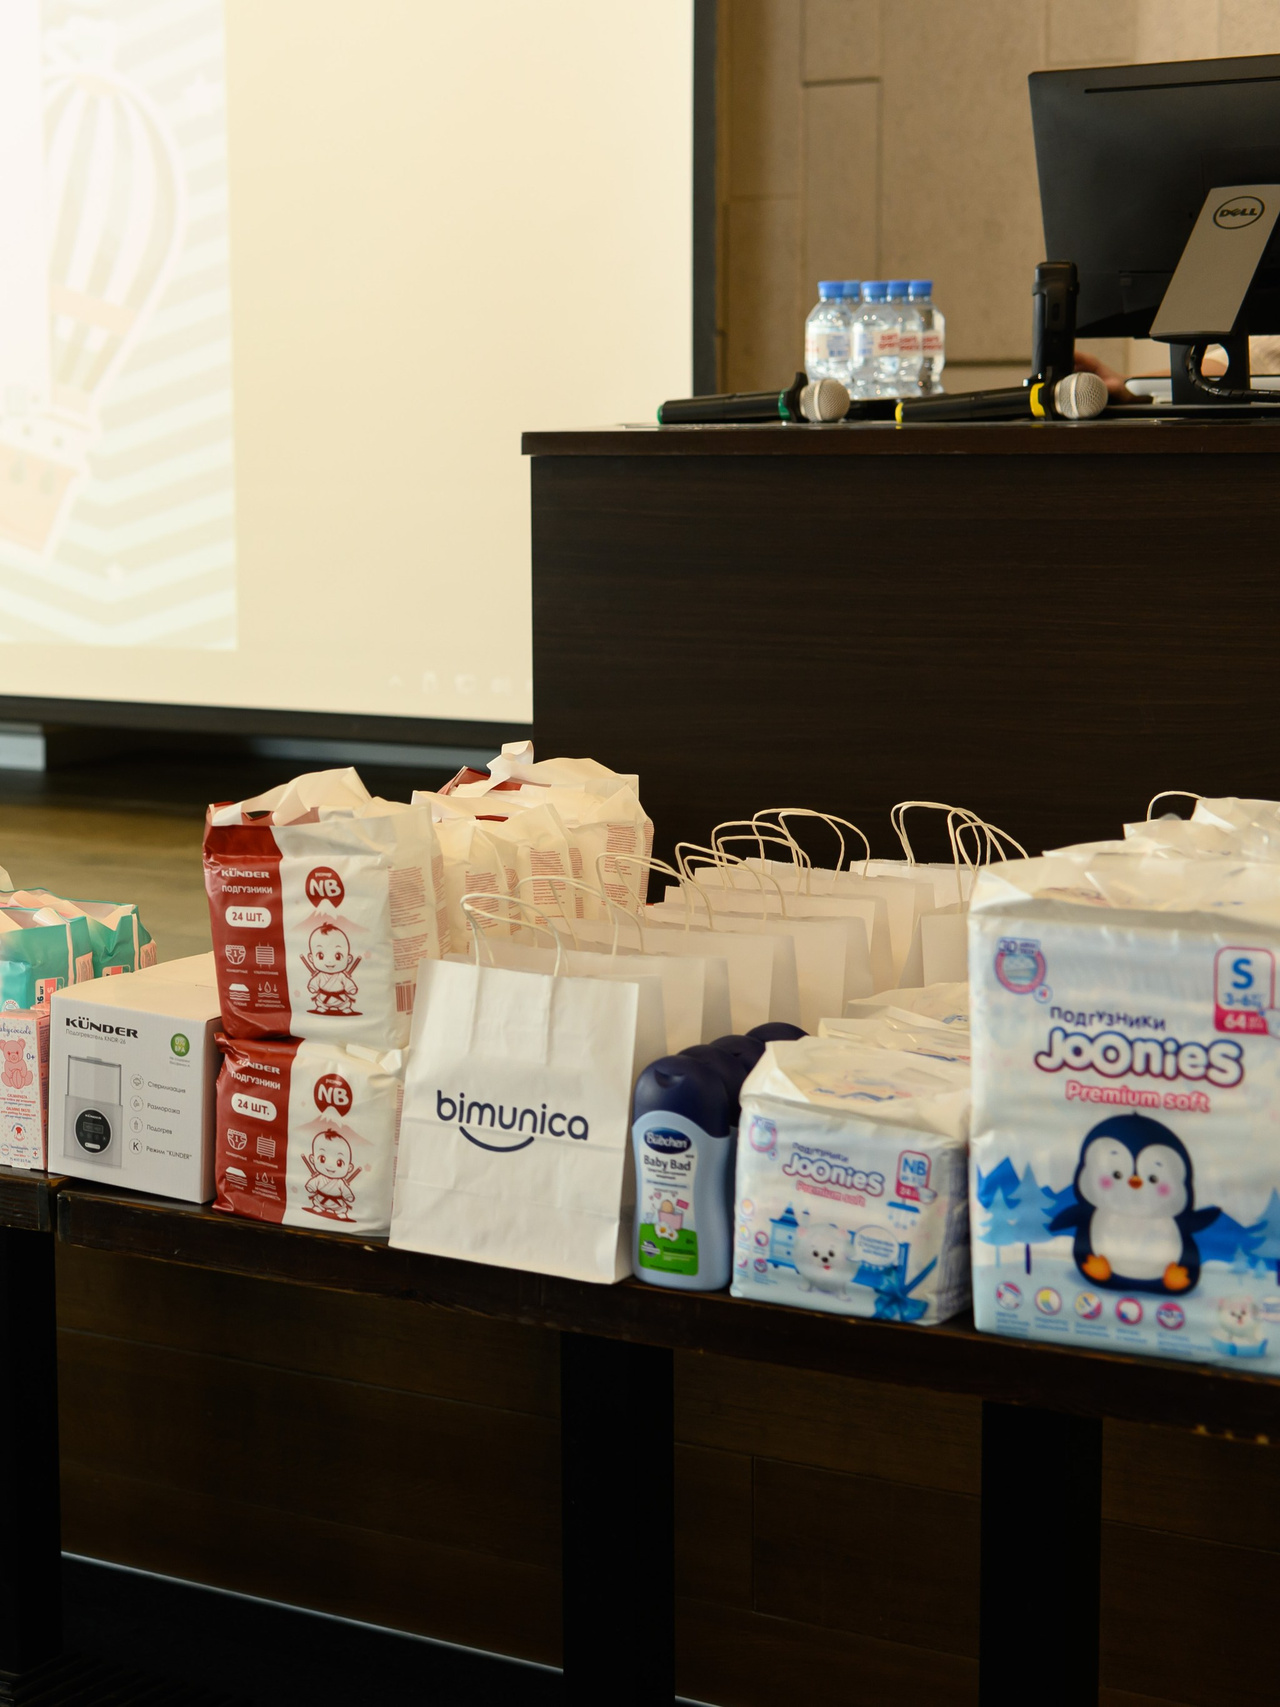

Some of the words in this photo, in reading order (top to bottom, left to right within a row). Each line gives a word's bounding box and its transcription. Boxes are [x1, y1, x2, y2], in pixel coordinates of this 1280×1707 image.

[1219, 208, 1257, 217] DELL
[221, 868, 270, 878] KÜNDER
[222, 885, 273, 894] ПОДГУЗНИКИ
[310, 879, 341, 897] NB
[232, 911, 243, 921] 24
[246, 912, 265, 923] ШТ.
[1231, 958, 1254, 989] S
[66, 1016, 138, 1038] KÜNDER
[1224, 1014, 1246, 1029] 64
[147, 1081, 186, 1094] Стерилизация
[231, 1071, 280, 1090] ПОДГУЗНИКИ
[318, 1084, 349, 1106] NB
[1066, 1080, 1161, 1108] Premium
[1162, 1091, 1211, 1112] soft
[147, 1103, 180, 1115] Разморозка
[237, 1099, 248, 1110] 24
[251, 1103, 270, 1115] ШТ.
[437, 1090, 589, 1141] bimunica
[147, 1124, 173, 1135] Подогрев
[646, 1131, 688, 1148] Bübchen
[146, 1146, 165, 1155] Режим
[644, 1155, 668, 1171] Baby
[670, 1159, 691, 1171] Bad
[902, 1158, 926, 1176] NB
[796, 1180, 842, 1202] Premium
